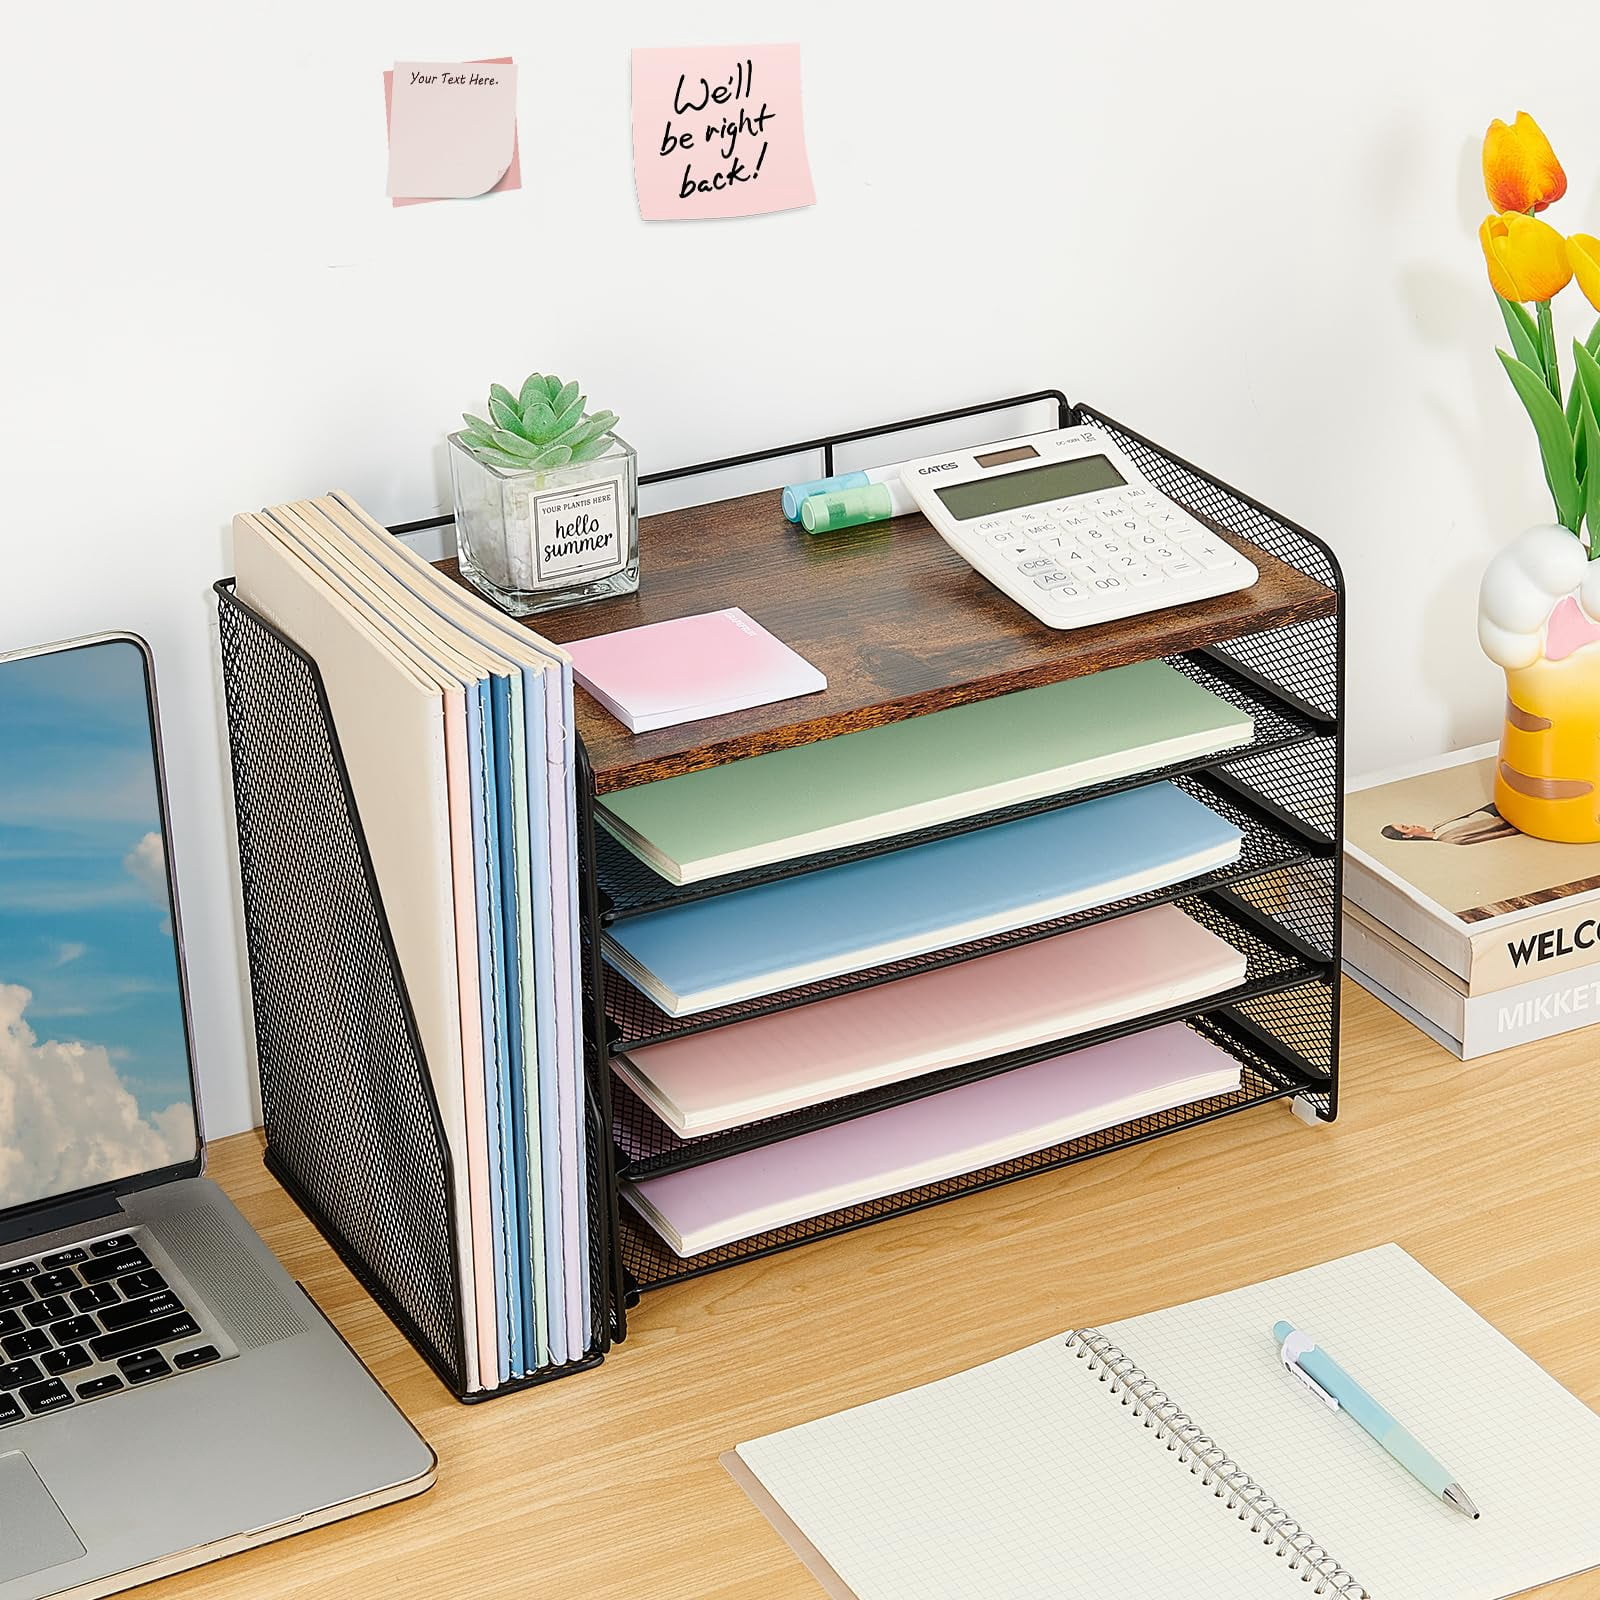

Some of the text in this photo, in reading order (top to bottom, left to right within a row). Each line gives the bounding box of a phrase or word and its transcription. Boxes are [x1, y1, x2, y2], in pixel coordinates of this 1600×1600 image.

[410, 71, 499, 86] Your Text Here.
[674, 59, 752, 115] We'll
[660, 103, 776, 159] be right
[679, 141, 768, 199] back!
[542, 505, 561, 515] YOUR
[592, 494, 611, 504] HERE
[555, 513, 600, 540] hello
[979, 520, 1001, 530] OFF
[1027, 523, 1056, 535] MRC
[1124, 521, 1137, 530] 9
[994, 532, 1015, 542] GT
[1088, 529, 1103, 539] 8
[1143, 535, 1156, 544] 6
[544, 532, 613, 563] summer
[1104, 542, 1119, 552] 5
[1158, 548, 1172, 557] 3
[1070, 551, 1082, 560] 4
[1121, 556, 1137, 566] 2
[1044, 572, 1067, 583] AC
[1095, 577, 1121, 589] 00
[1507, 919, 1600, 969] WELC
[117, 1260, 142, 1271] delete
[149, 1303, 175, 1314] return
[172, 1324, 190, 1334] shift
[40, 1393, 68, 1406] option
